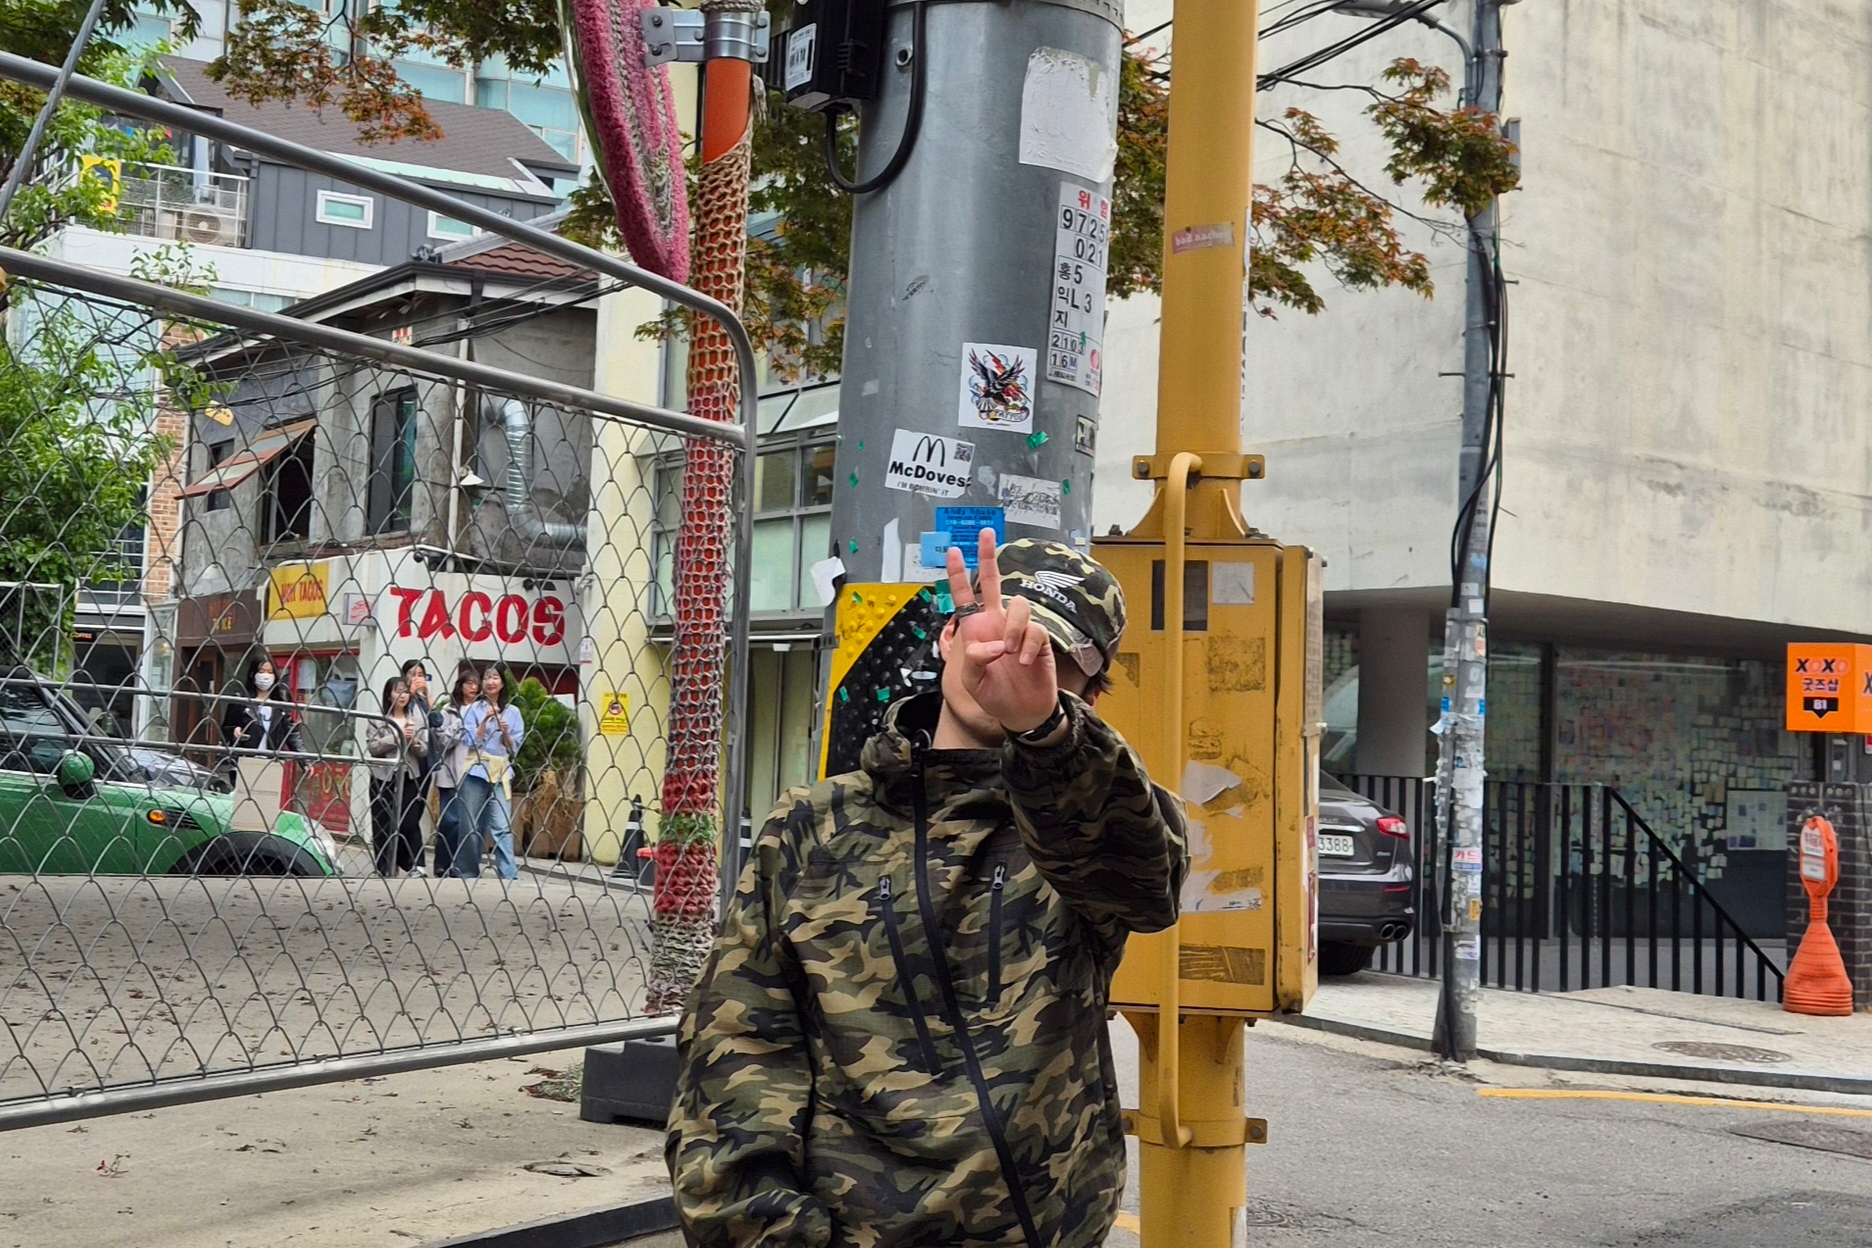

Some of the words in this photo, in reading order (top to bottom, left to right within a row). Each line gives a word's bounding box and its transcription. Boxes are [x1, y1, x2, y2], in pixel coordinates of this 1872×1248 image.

[1019, 578, 1078, 615] HONDA
[390, 586, 566, 646] TACOS
[1795, 658, 1850, 673] XOXO
[1803, 677, 1839, 692] 굿즈샵
[1813, 699, 1828, 710] B1
